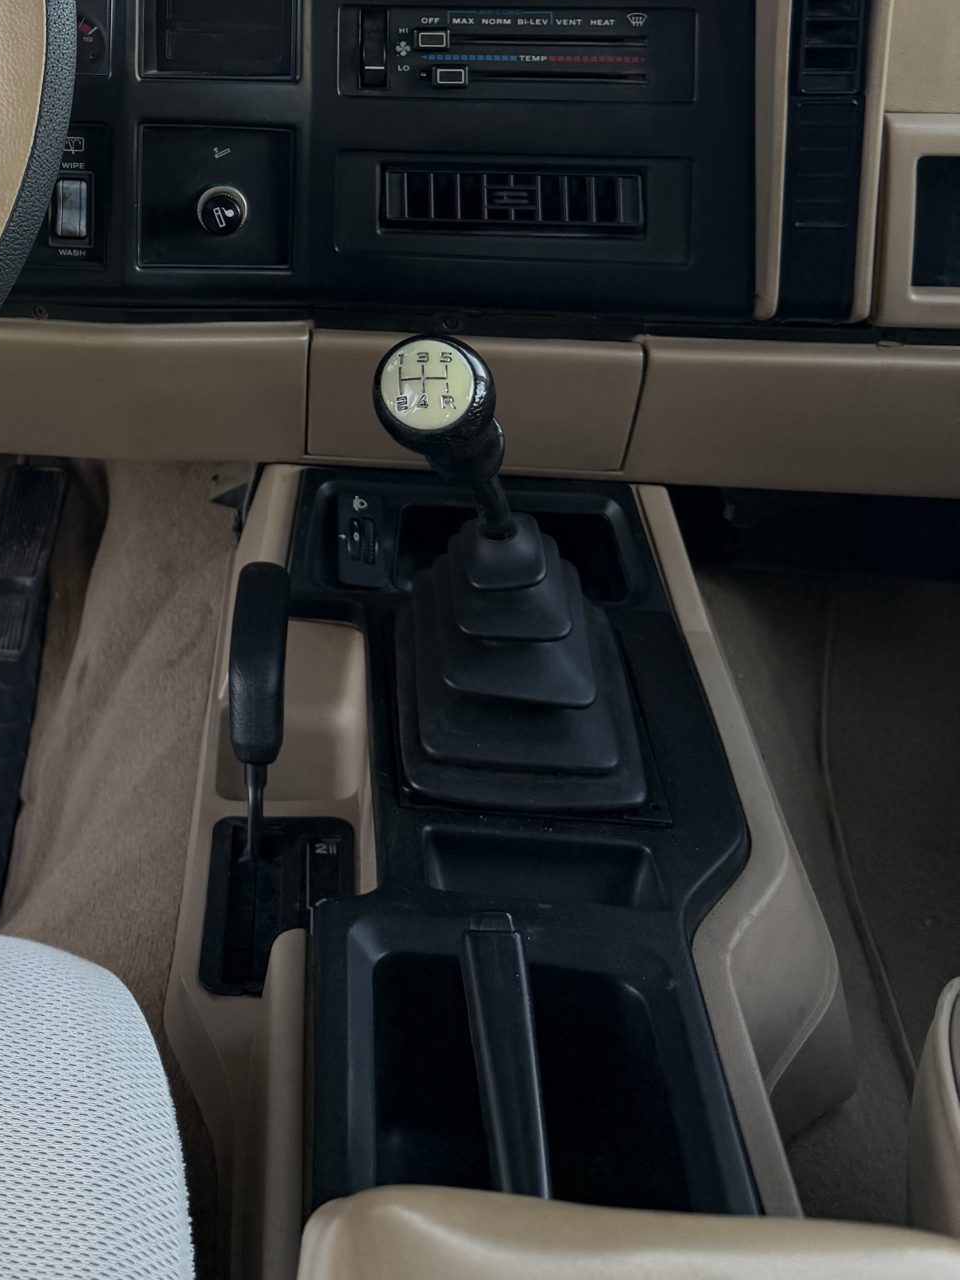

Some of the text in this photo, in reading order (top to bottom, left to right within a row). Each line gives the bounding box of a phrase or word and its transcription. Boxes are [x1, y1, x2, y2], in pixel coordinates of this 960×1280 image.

[452, 17, 475, 25] MAX
[517, 18, 548, 26] BI-LEV
[555, 18, 582, 26] VENT
[590, 19, 616, 27] HEAT
[398, 27, 409, 35] HI
[519, 55, 547, 63] TEMP
[397, 64, 410, 72] LO
[61, 162, 85, 170] WIPE
[58, 248, 86, 258] WASH
[398, 351, 453, 365] 1 3 5
[395, 394, 457, 412] 2 4 R
